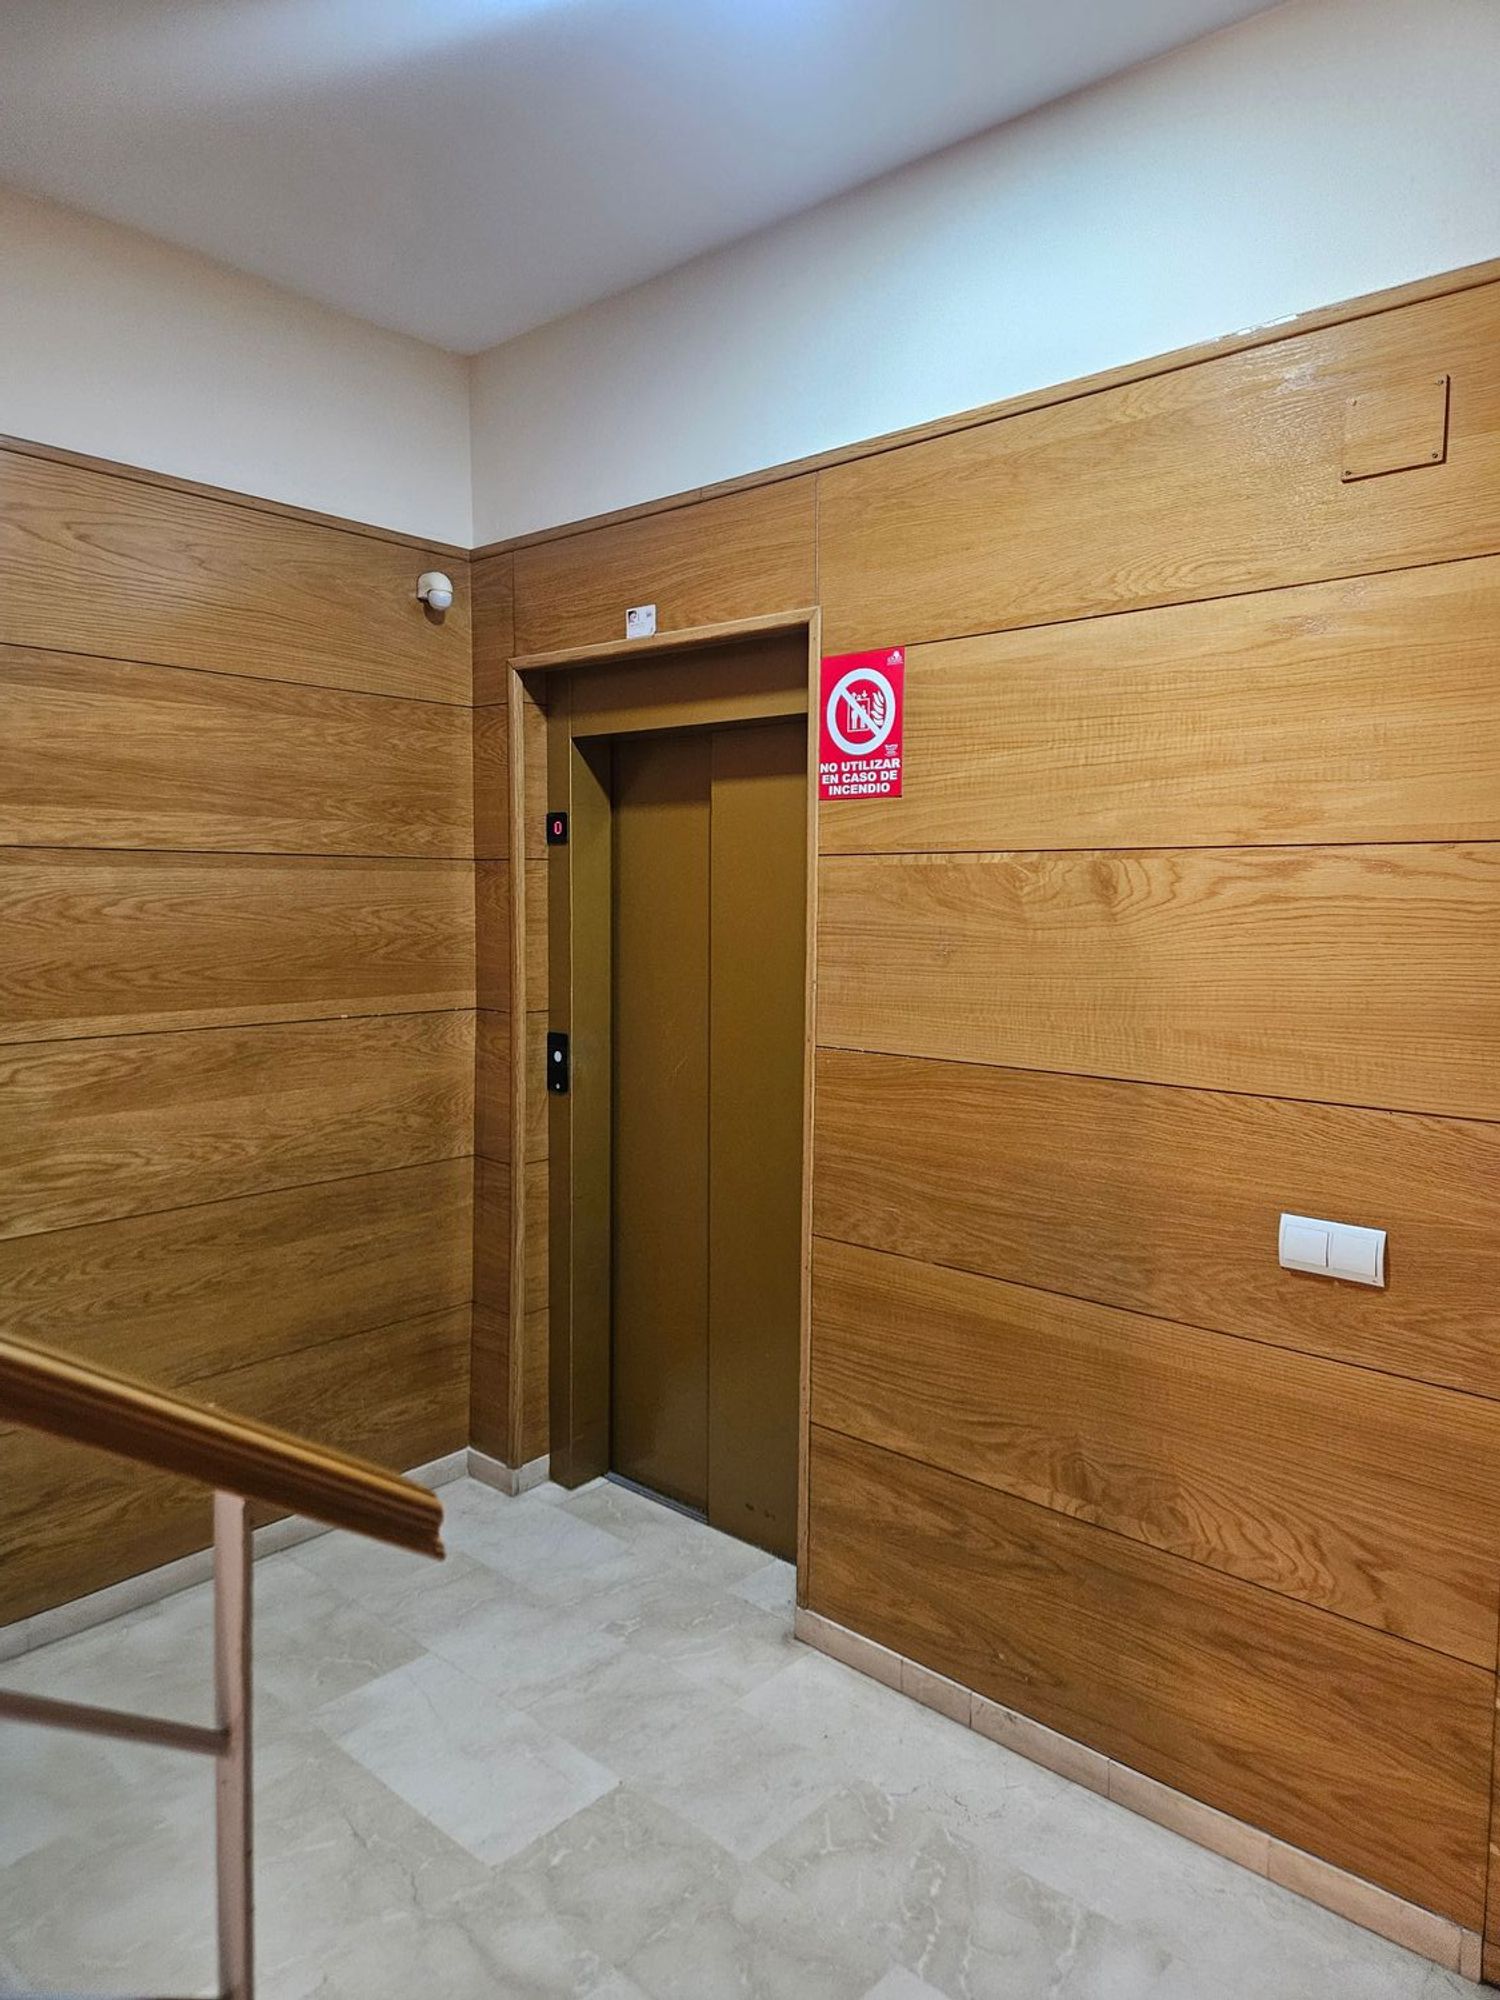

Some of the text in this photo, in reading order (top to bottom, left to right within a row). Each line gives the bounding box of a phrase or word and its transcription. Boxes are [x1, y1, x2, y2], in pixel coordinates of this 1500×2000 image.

[820, 758, 900, 773] NO UTILIZAR
[822, 770, 897, 784] EN CASO DE
[829, 783, 890, 795] INCENDIO
[554, 821, 562, 835] 0
